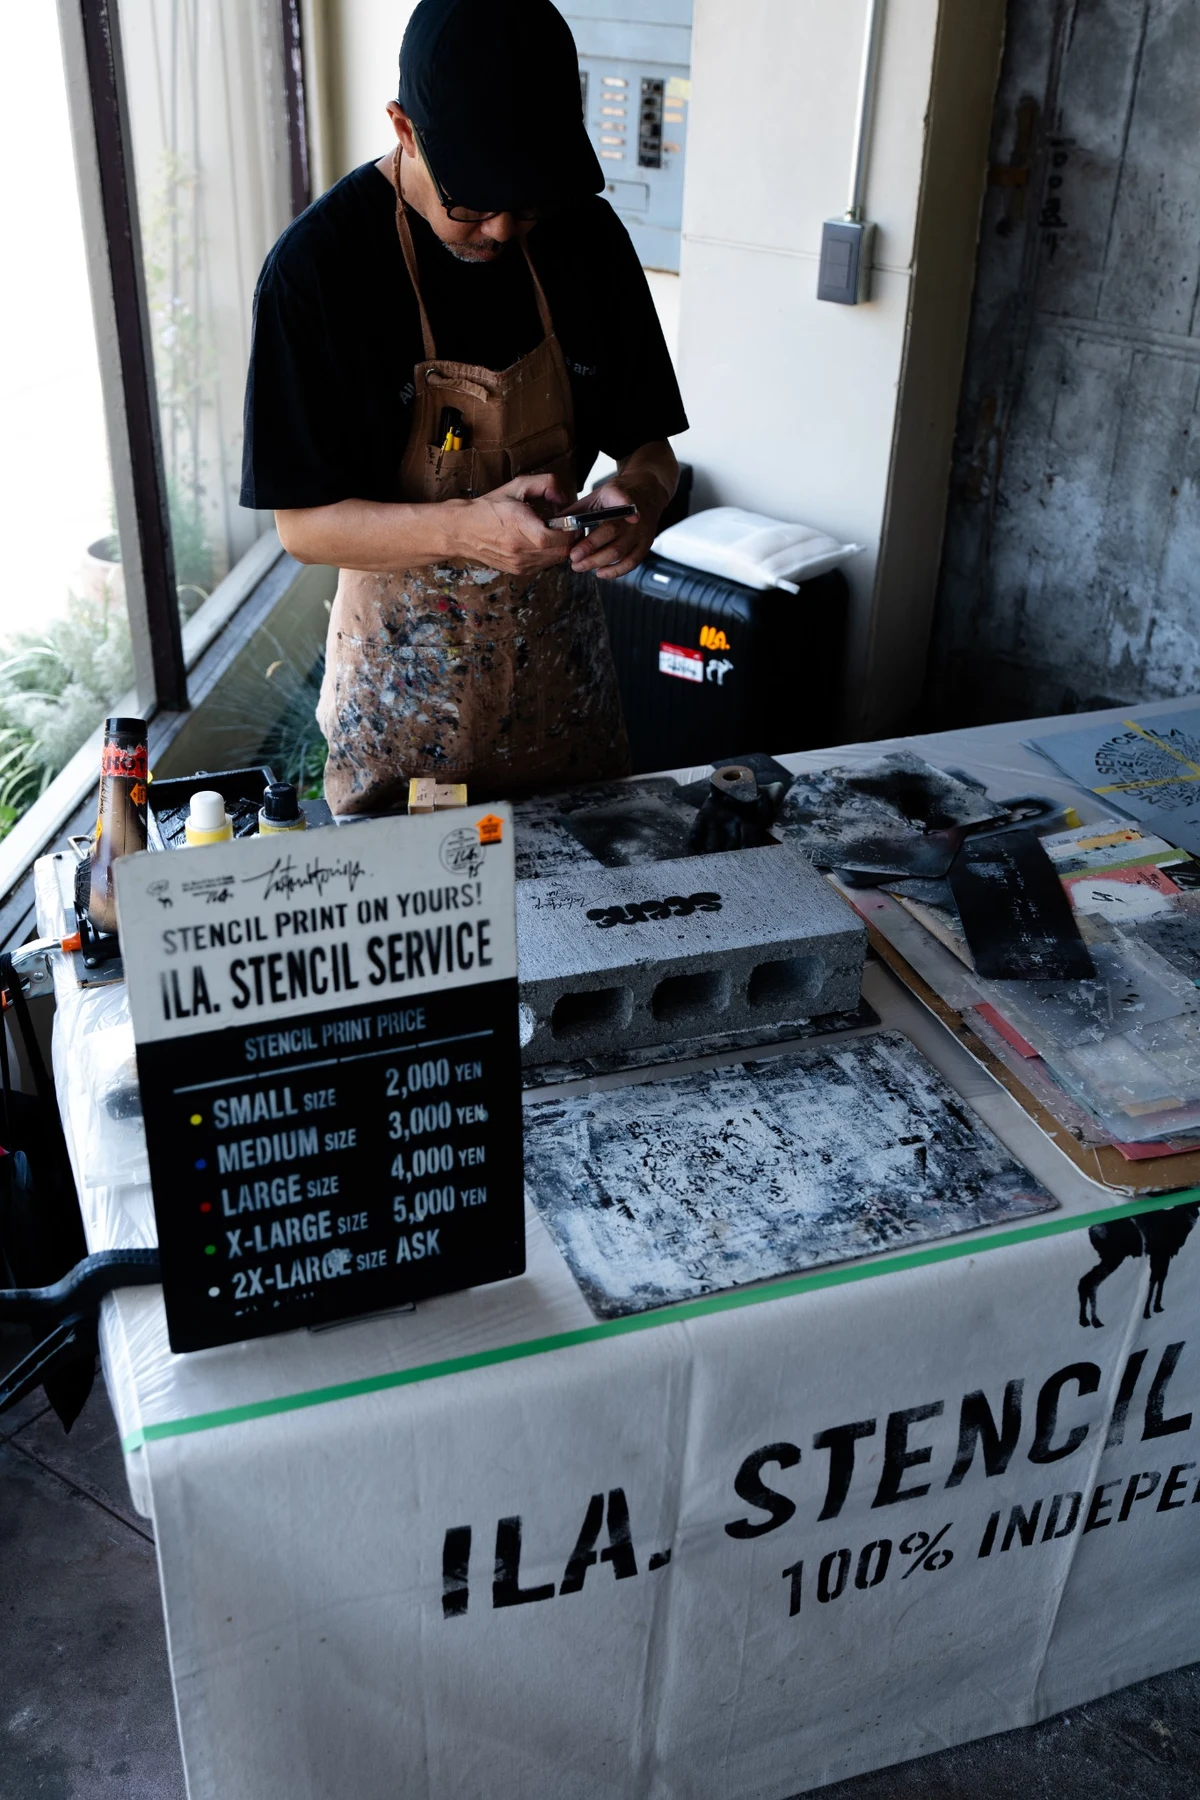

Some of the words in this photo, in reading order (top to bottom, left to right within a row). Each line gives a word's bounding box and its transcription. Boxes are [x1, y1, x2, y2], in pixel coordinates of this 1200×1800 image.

[162, 917, 267, 955] STENCIL
[276, 903, 348, 938] PRINT
[357, 898, 389, 925] ON
[397, 882, 483, 918] YOURS!
[160, 963, 221, 1020] ILA.
[230, 942, 359, 1009] STENCIL
[367, 919, 494, 986] SERVICE
[245, 1023, 318, 1062] STENCIL
[321, 1015, 373, 1047] PRINT
[377, 1007, 427, 1038] PRICE
[213, 1086, 299, 1130] SMALL
[303, 1088, 337, 1111] SIZE
[385, 1058, 450, 1099] 2,000
[455, 1061, 483, 1083] YEN
[217, 1126, 318, 1174] MEDIUM
[324, 1128, 357, 1152] SIZE
[388, 1101, 452, 1142] 3,000
[456, 1104, 486, 1126] YEN
[222, 1173, 302, 1217] LARGE
[306, 1175, 340, 1199] SIZE
[391, 1144, 454, 1184] 4,000
[458, 1145, 486, 1168] YEN
[226, 1210, 332, 1259] X-LARGE
[337, 1211, 369, 1235] SIZE
[393, 1185, 456, 1224] 5,000
[460, 1186, 488, 1208] YEN
[231, 1248, 353, 1299] 2X-LARGE
[356, 1249, 388, 1272] SIZE
[396, 1228, 441, 1264] ASK
[441, 1486, 672, 1620] ILA.
[724, 1340, 1193, 1540] STENCIL
[781, 1521, 956, 1618] 100%
[977, 1461, 1200, 1558] INDEPE
